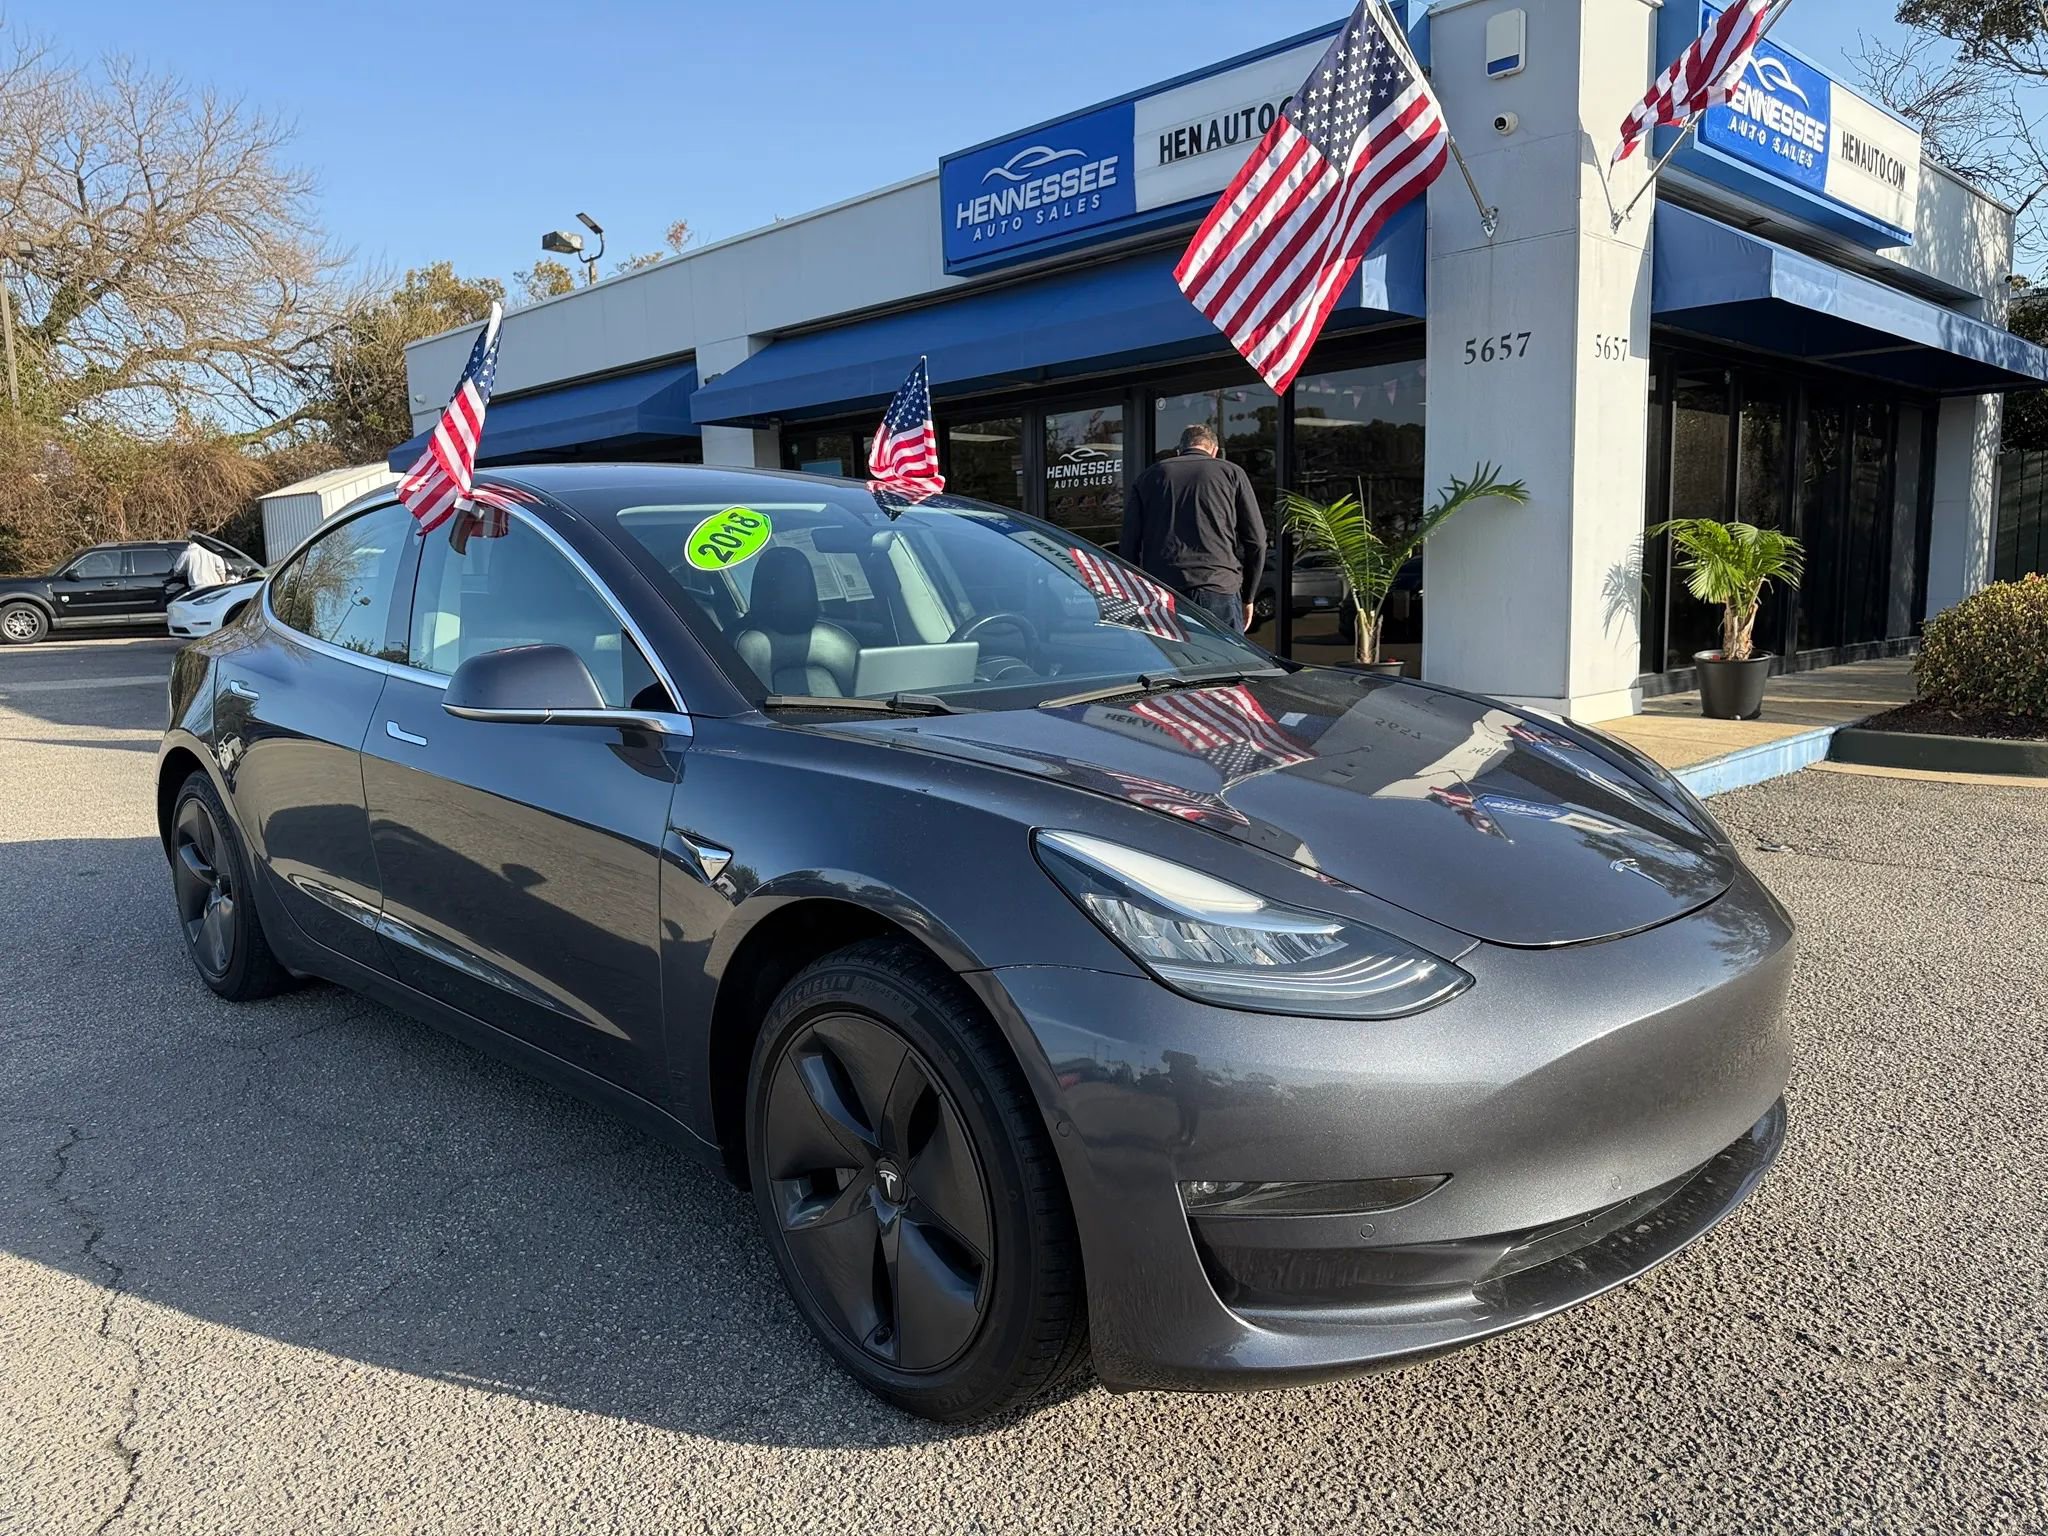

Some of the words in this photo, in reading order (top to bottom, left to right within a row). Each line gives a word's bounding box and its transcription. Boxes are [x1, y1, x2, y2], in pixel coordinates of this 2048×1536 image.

[1728, 82, 1827, 154] ENNESSEE
[1728, 116, 1766, 145] AUTO
[1773, 135, 1814, 169] SALES
[956, 155, 1119, 229] HENNESSEE
[973, 217, 1022, 242] AUTO
[1036, 194, 1101, 224] SALES
[1464, 332, 1532, 365] 5657
[1594, 334, 1628, 362] 5657
[1046, 459, 1123, 479] HENNESSEE
[1054, 478, 1080, 489] AUTO
[1083, 475, 1113, 487] SALES
[698, 512, 761, 564] 2018
